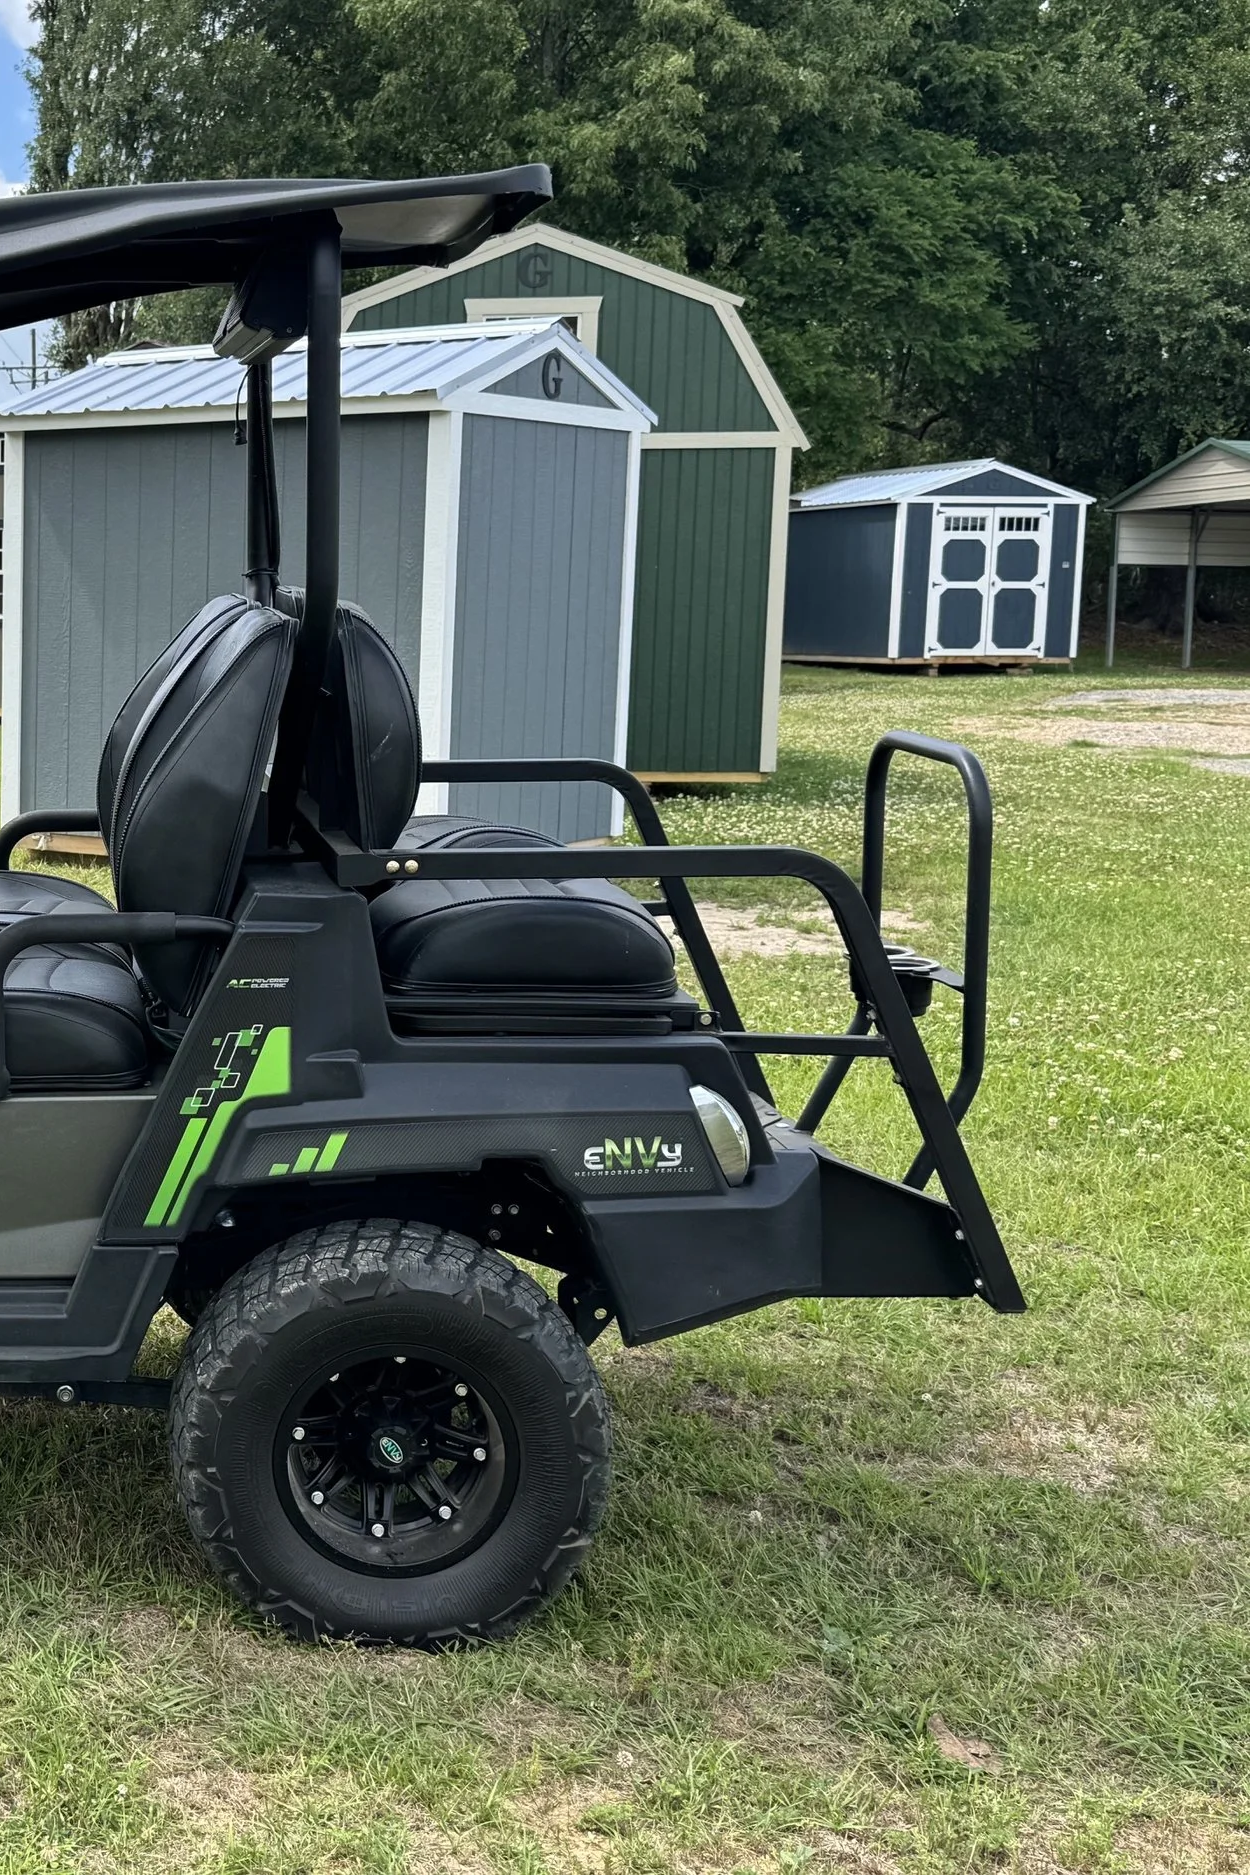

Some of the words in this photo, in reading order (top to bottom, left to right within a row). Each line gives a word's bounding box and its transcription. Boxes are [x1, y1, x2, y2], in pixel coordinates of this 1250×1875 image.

[518, 252, 553, 289] G
[541, 352, 564, 400] G
[226, 978, 252, 989] AC
[574, 1168, 650, 1177] NEIGHBORHOOD
[654, 1166, 695, 1174] VEHICLE
